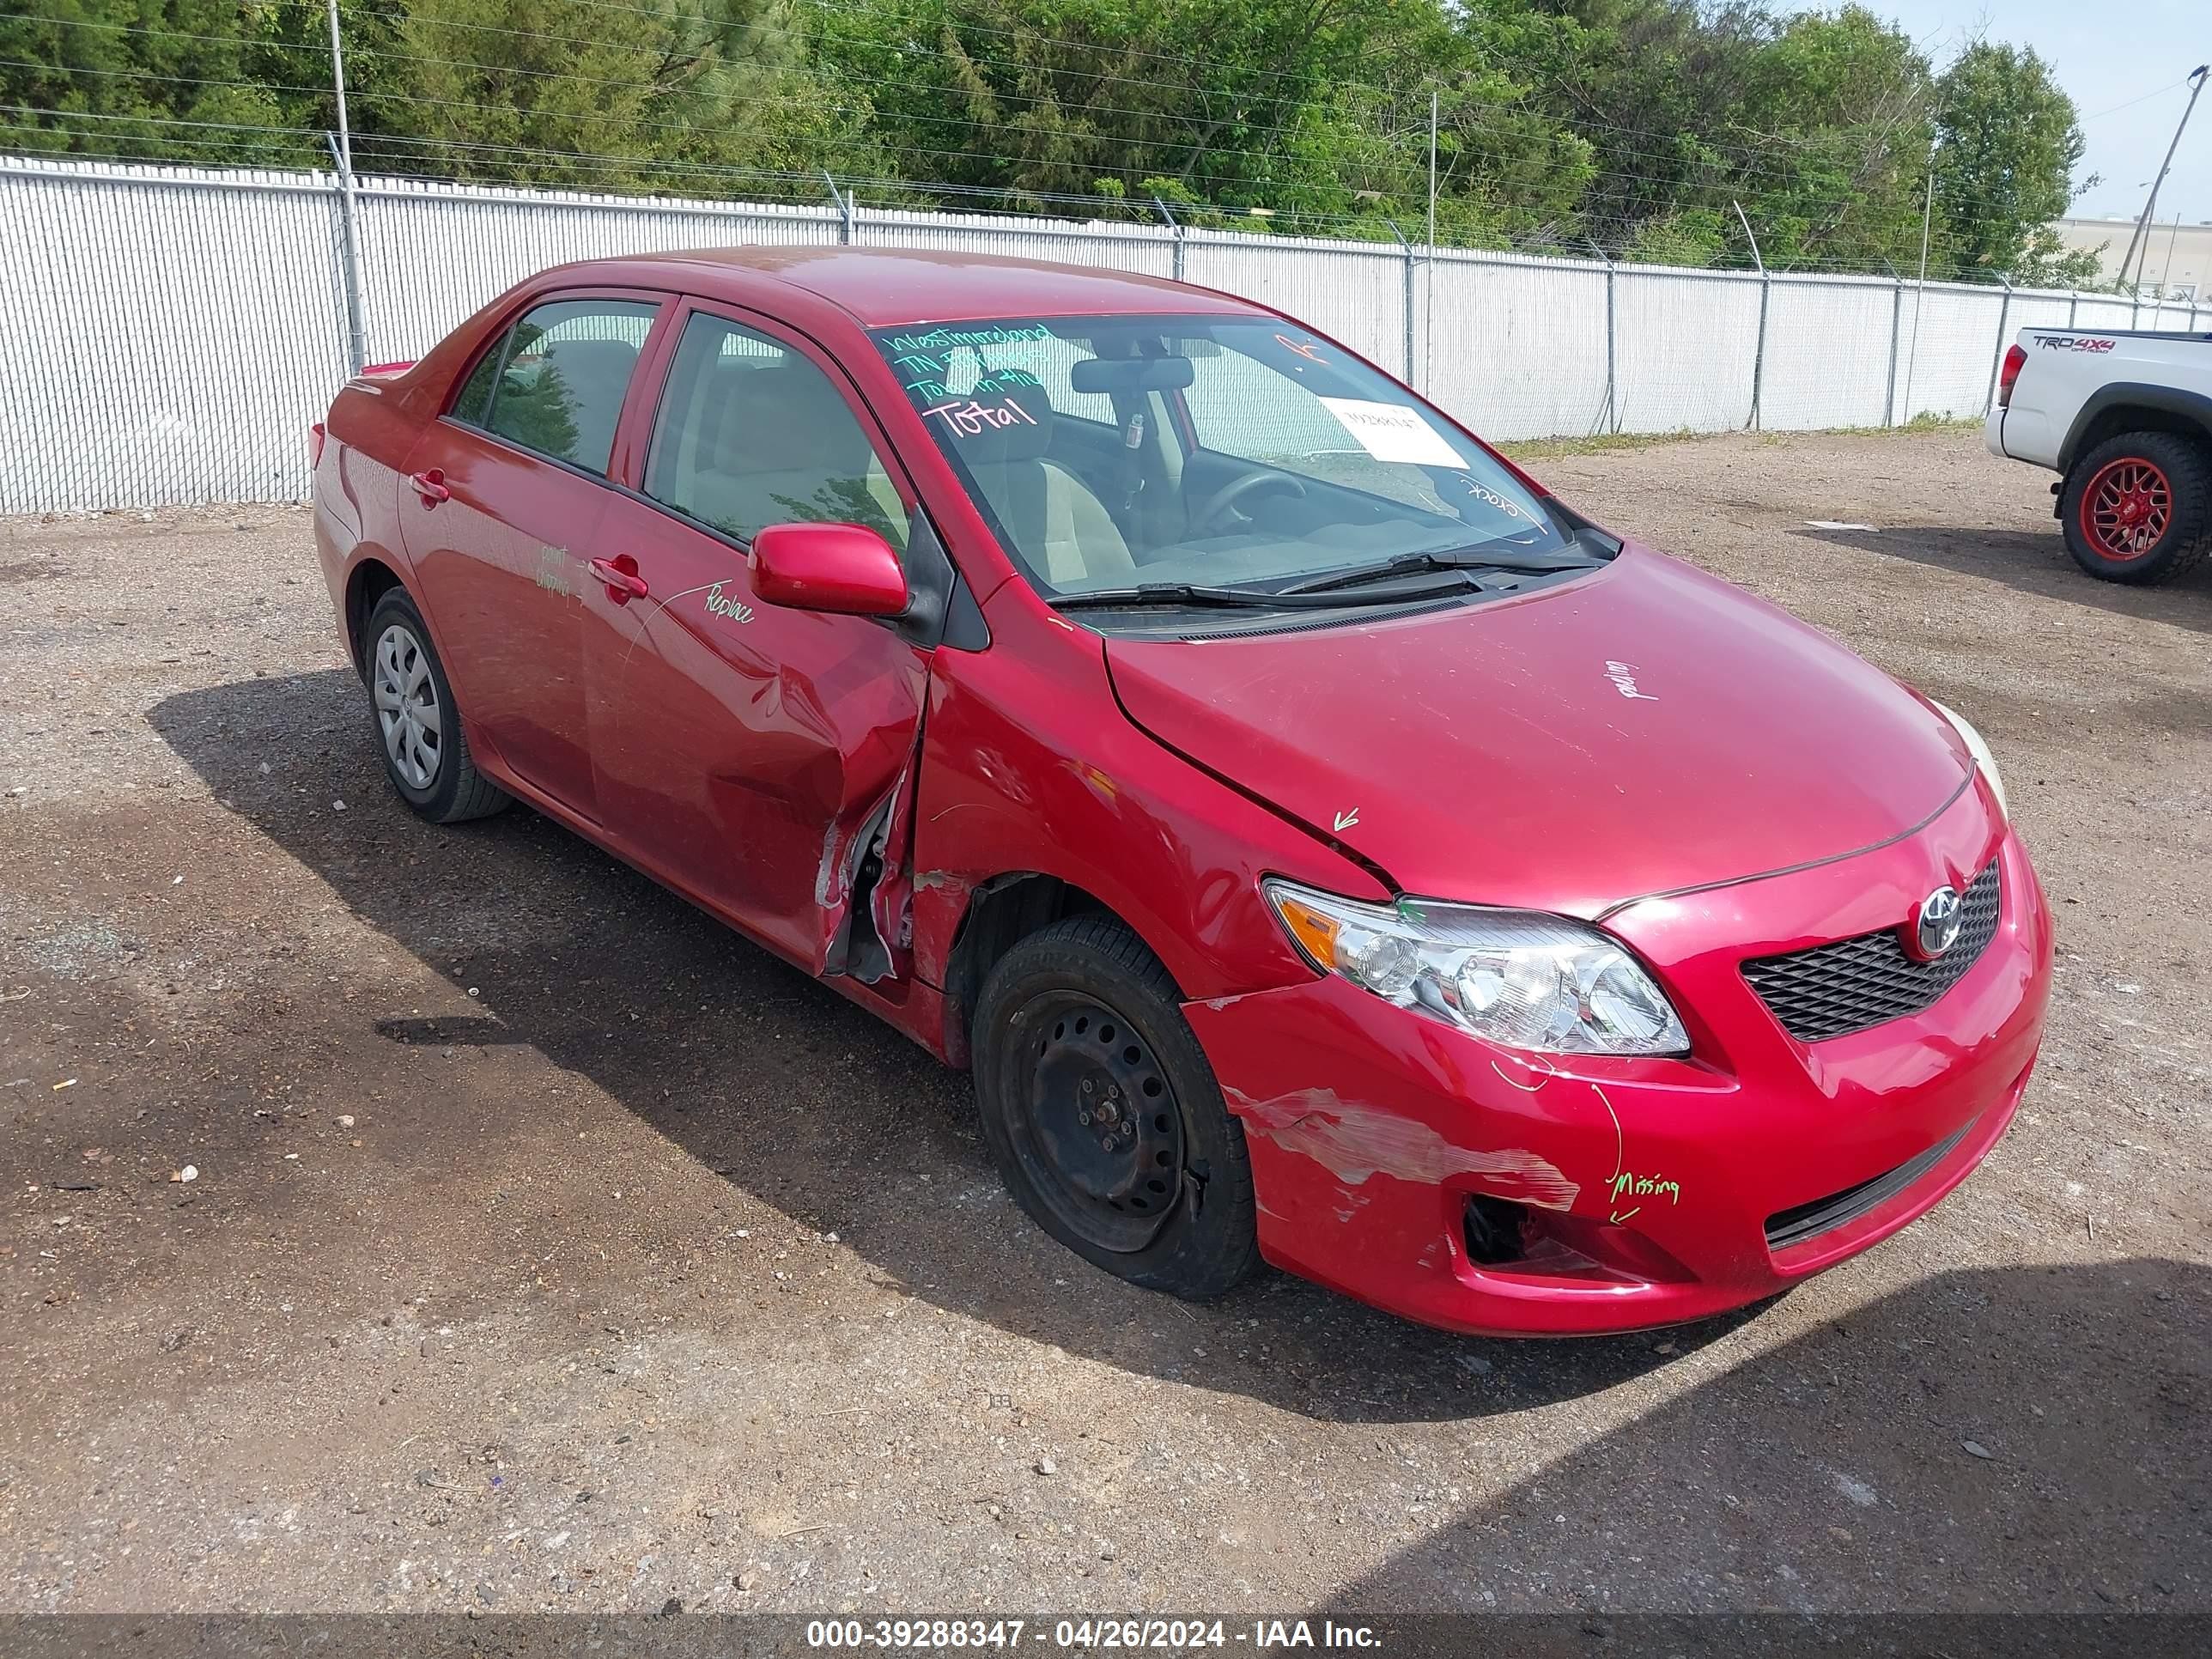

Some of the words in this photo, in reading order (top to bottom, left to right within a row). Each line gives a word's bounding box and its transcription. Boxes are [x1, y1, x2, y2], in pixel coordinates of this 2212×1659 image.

[883, 323, 1058, 352] Westmoreland
[894, 355, 943, 374] TN
[922, 398, 1038, 439] Total
[703, 583, 756, 624] Replace
[1610, 1171, 1680, 1206] Missing
